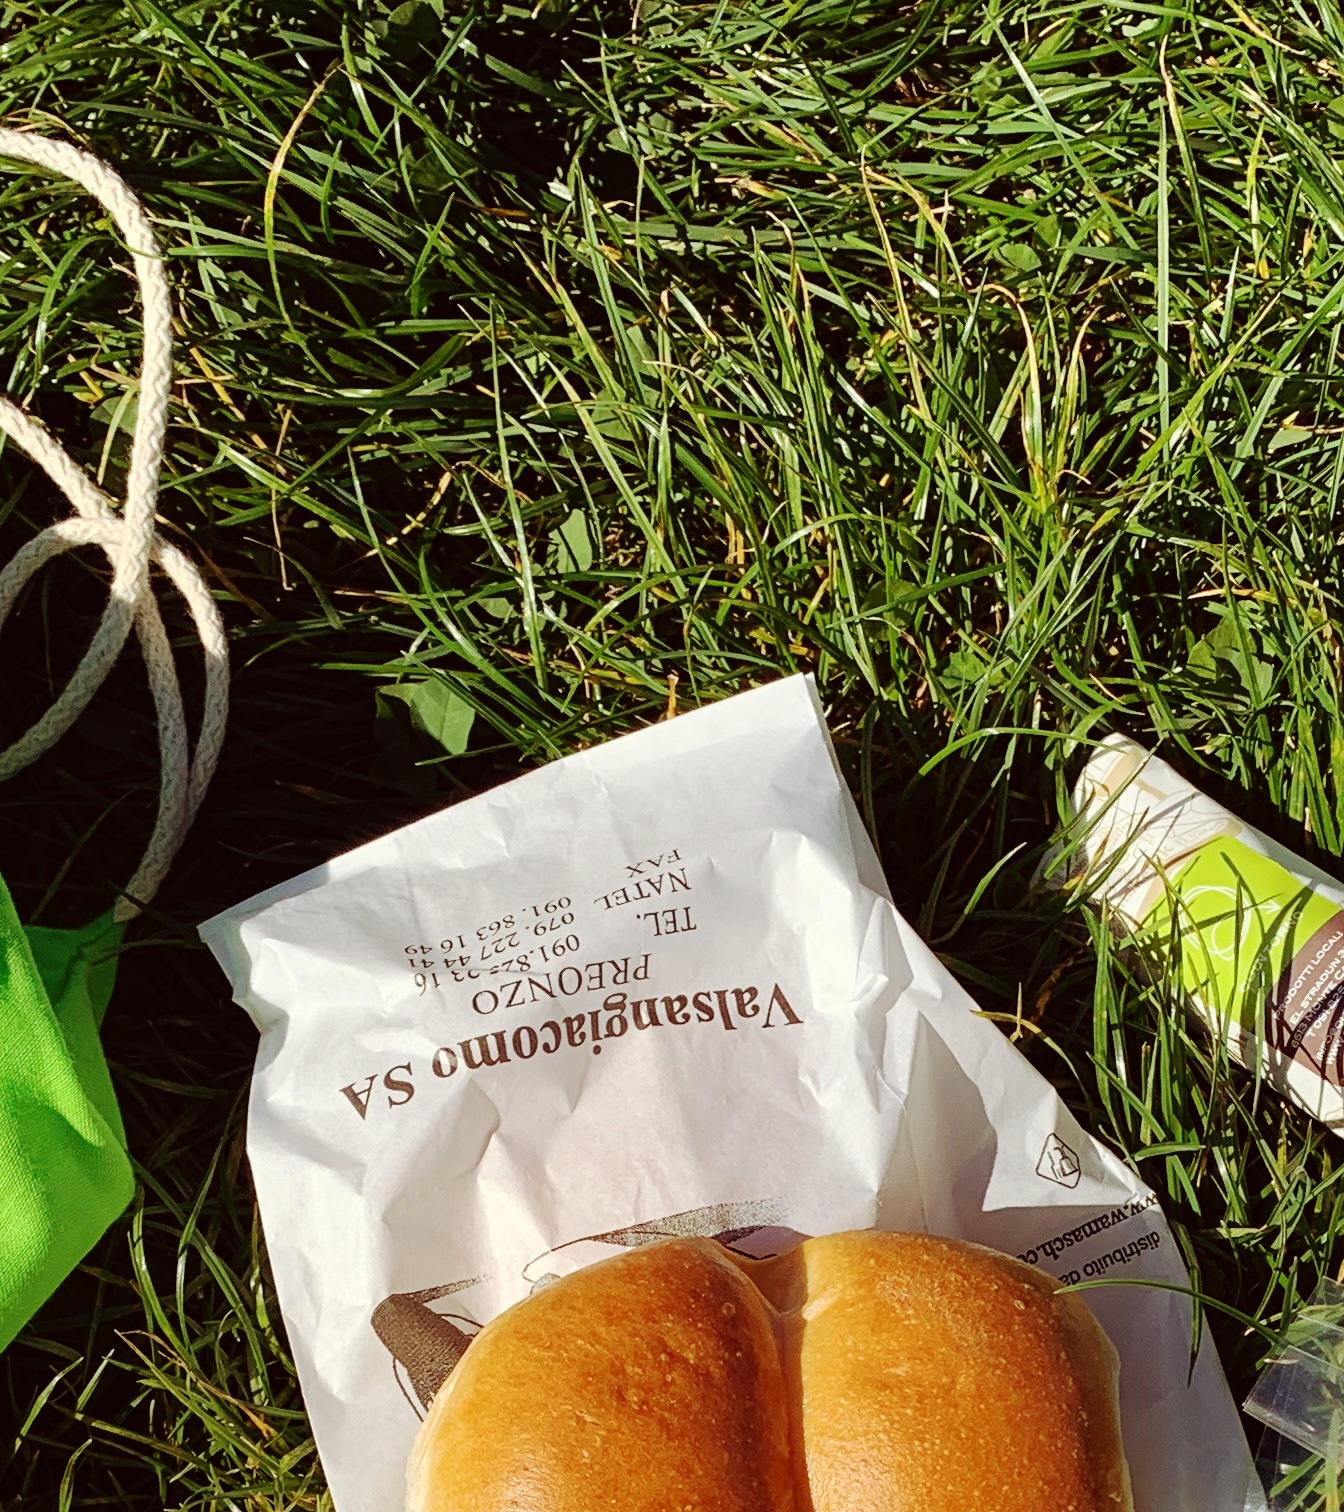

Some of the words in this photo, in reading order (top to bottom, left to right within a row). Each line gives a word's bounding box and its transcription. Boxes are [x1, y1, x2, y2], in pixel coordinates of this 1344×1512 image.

[624, 848, 683, 878] FAX
[593, 867, 692, 910] NATEL
[476, 914, 516, 941] 863
[636, 906, 697, 936] TEL.
[404, 944, 433, 955] 49
[440, 935, 466, 954] 16
[479, 932, 520, 961] 227
[1312, 931, 1344, 965] LOCALI
[443, 955, 471, 969] 44
[414, 973, 440, 996] 16
[471, 953, 652, 1015] PREONZO
[1290, 1009, 1304, 1026] EL
[1301, 959, 1340, 1009] STRADUN
[431, 981, 805, 1080] Valsangiacomo
[339, 1063, 416, 1120] SA
[1083, 1231, 1160, 1277] distribuito
